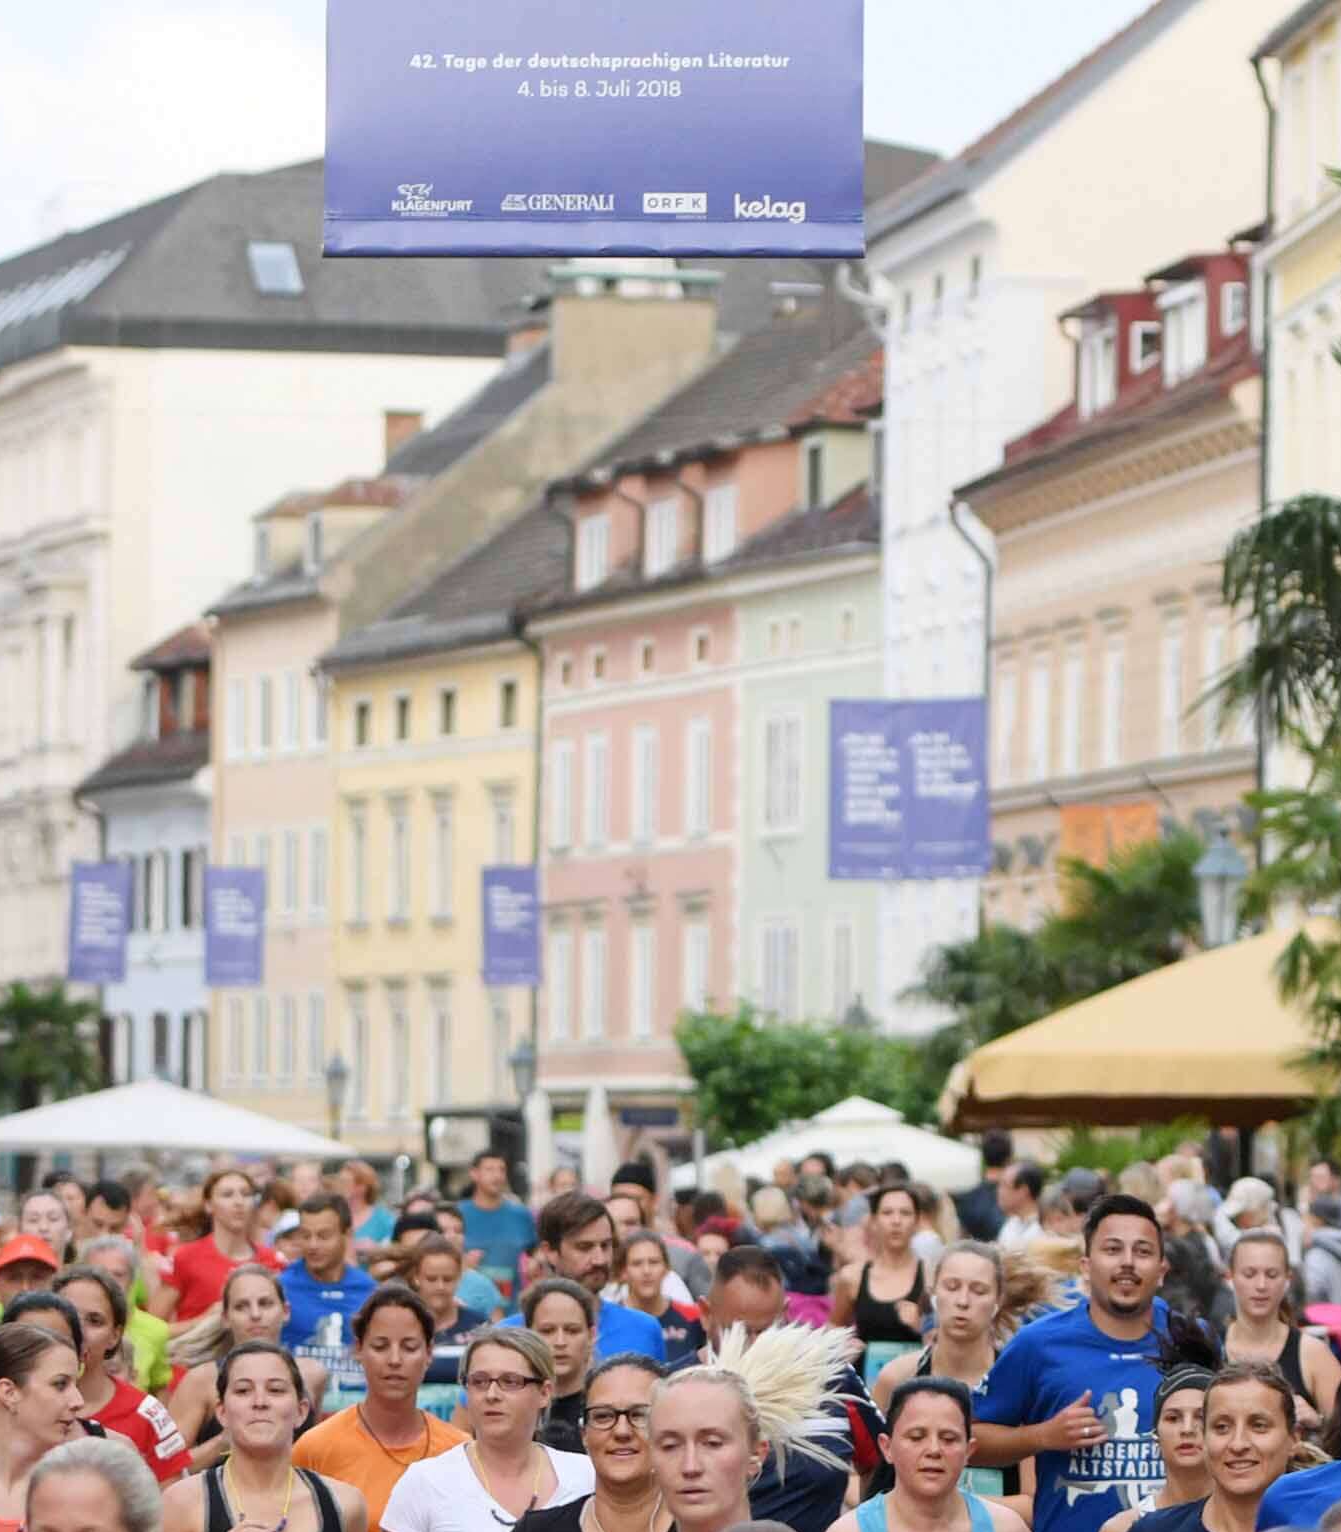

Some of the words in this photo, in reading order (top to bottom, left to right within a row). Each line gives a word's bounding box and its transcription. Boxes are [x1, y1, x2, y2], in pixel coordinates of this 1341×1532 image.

[410, 55, 437, 70] 42.
[443, 54, 487, 72] Tage
[492, 53, 521, 69] der
[527, 52, 703, 72] deutschsprachigen
[707, 52, 791, 69] Literatur
[517, 81, 535, 98] 4.
[540, 80, 569, 98] bis
[574, 81, 592, 98] 8.
[596, 80, 631, 98] Juli
[636, 81, 682, 98] 2018
[391, 200, 474, 212] KLAGENFURT
[528, 193, 614, 212] GENERALI
[647, 196, 686, 210] ORF
[733, 193, 806, 224] kelag
